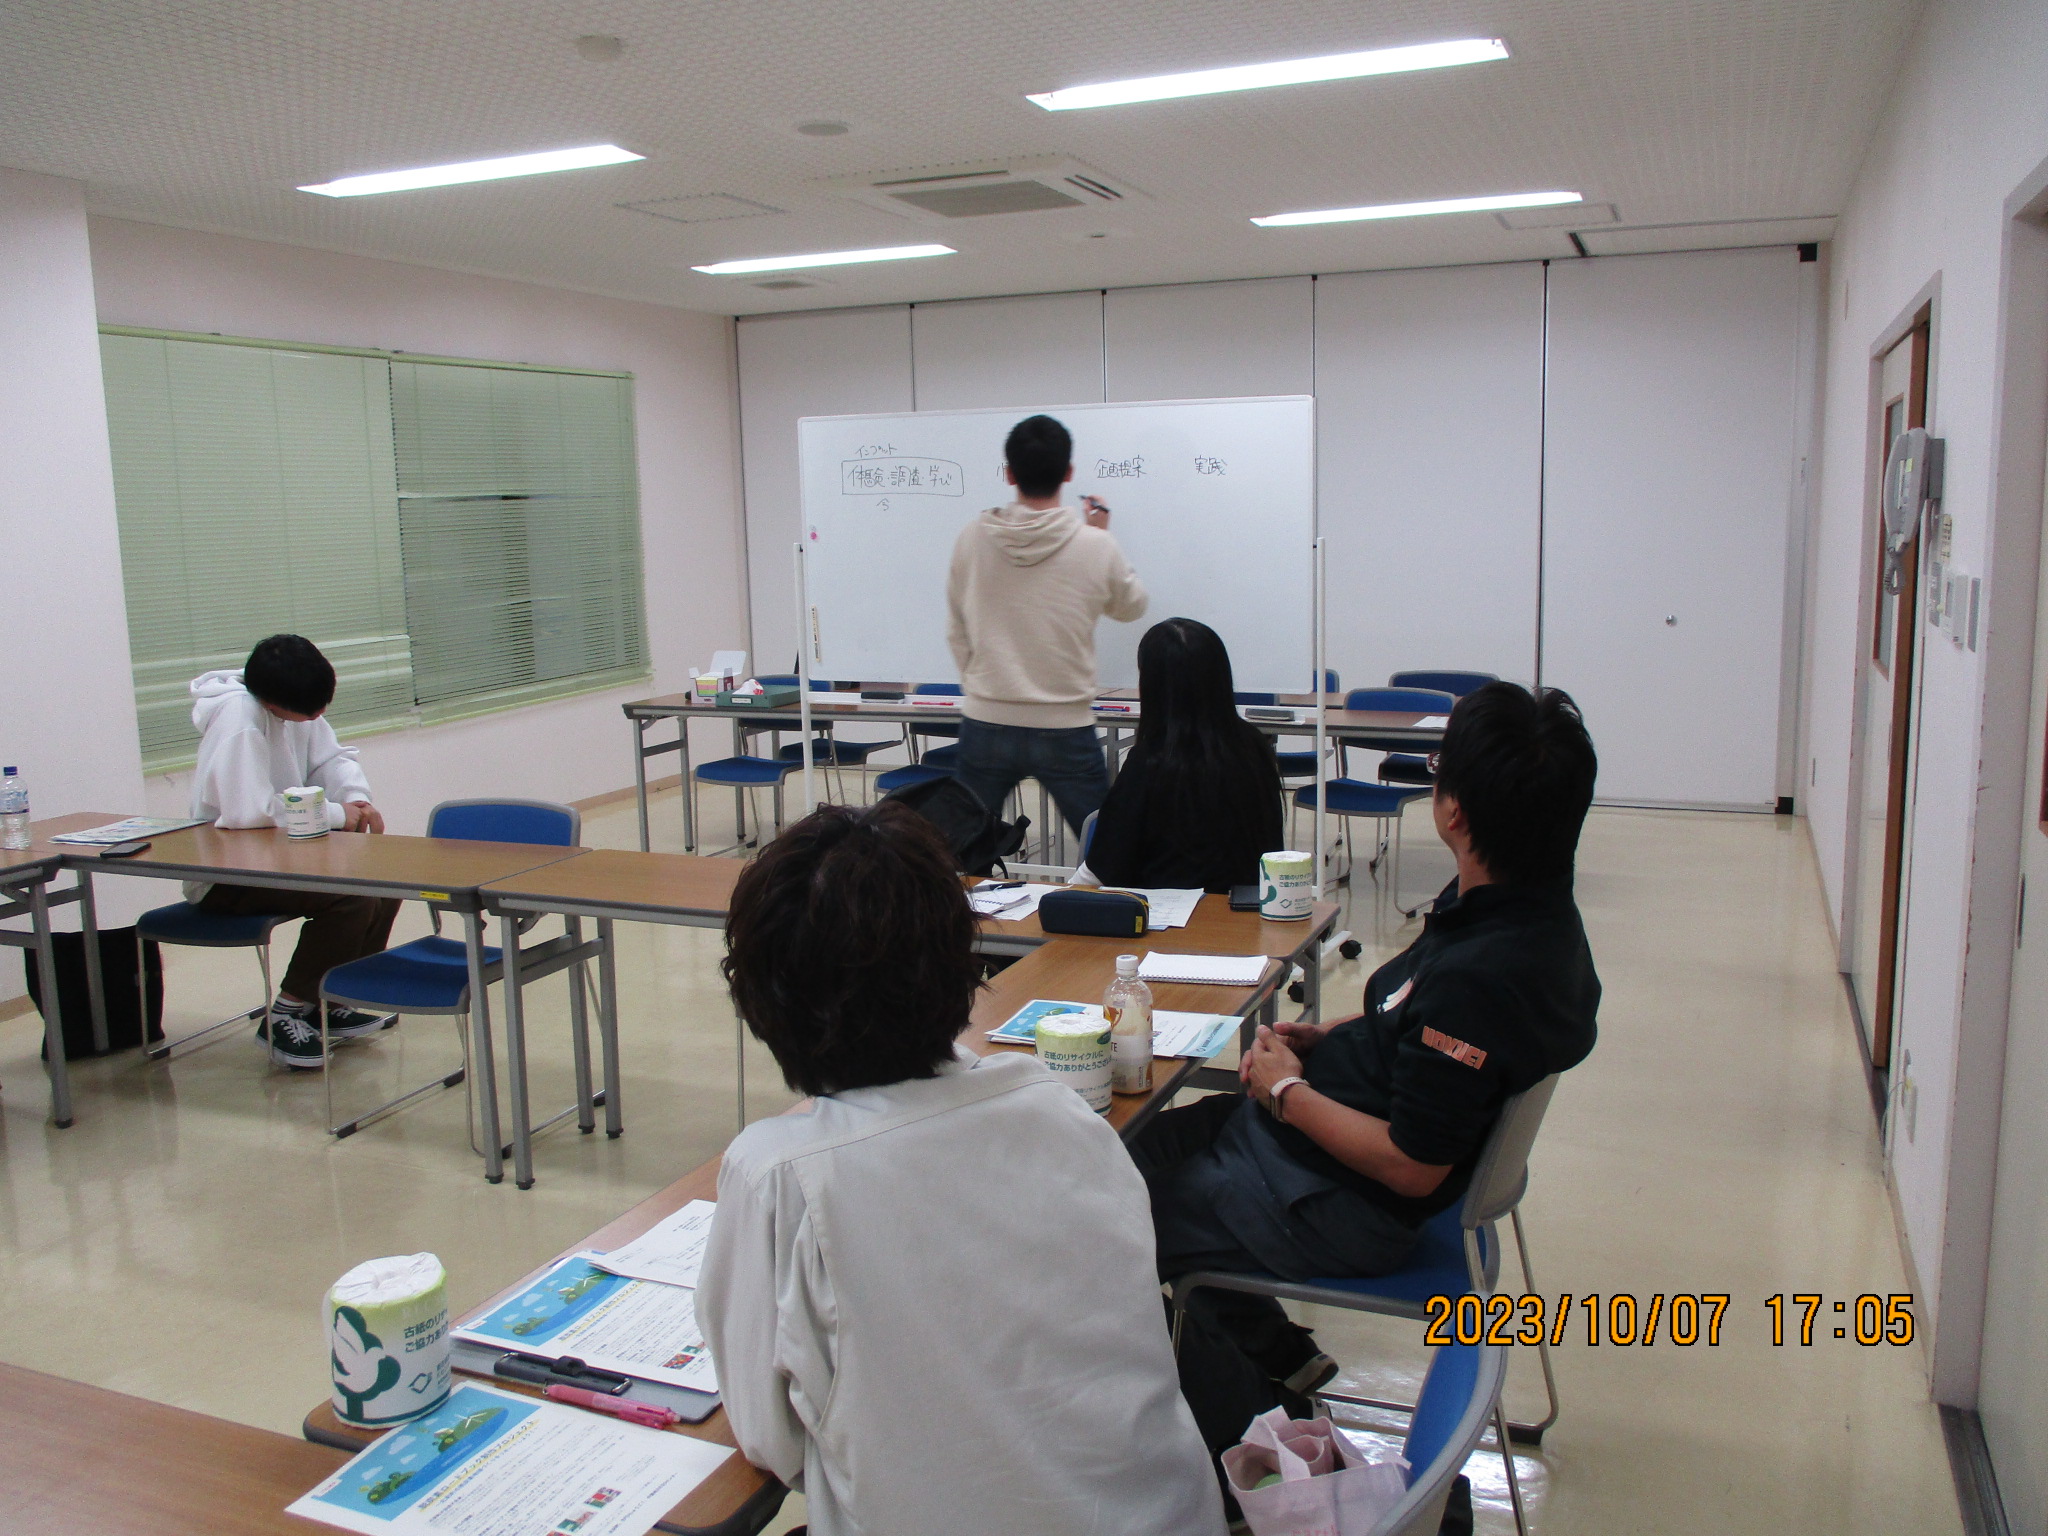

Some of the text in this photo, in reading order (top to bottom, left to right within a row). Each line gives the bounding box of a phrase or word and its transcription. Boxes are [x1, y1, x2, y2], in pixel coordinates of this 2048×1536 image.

[1094, 454, 1147, 479] 企画提案
[1194, 454, 1228, 476] 実践
[1044, 1050, 1104, 1061] 古紙のリサイクルに
